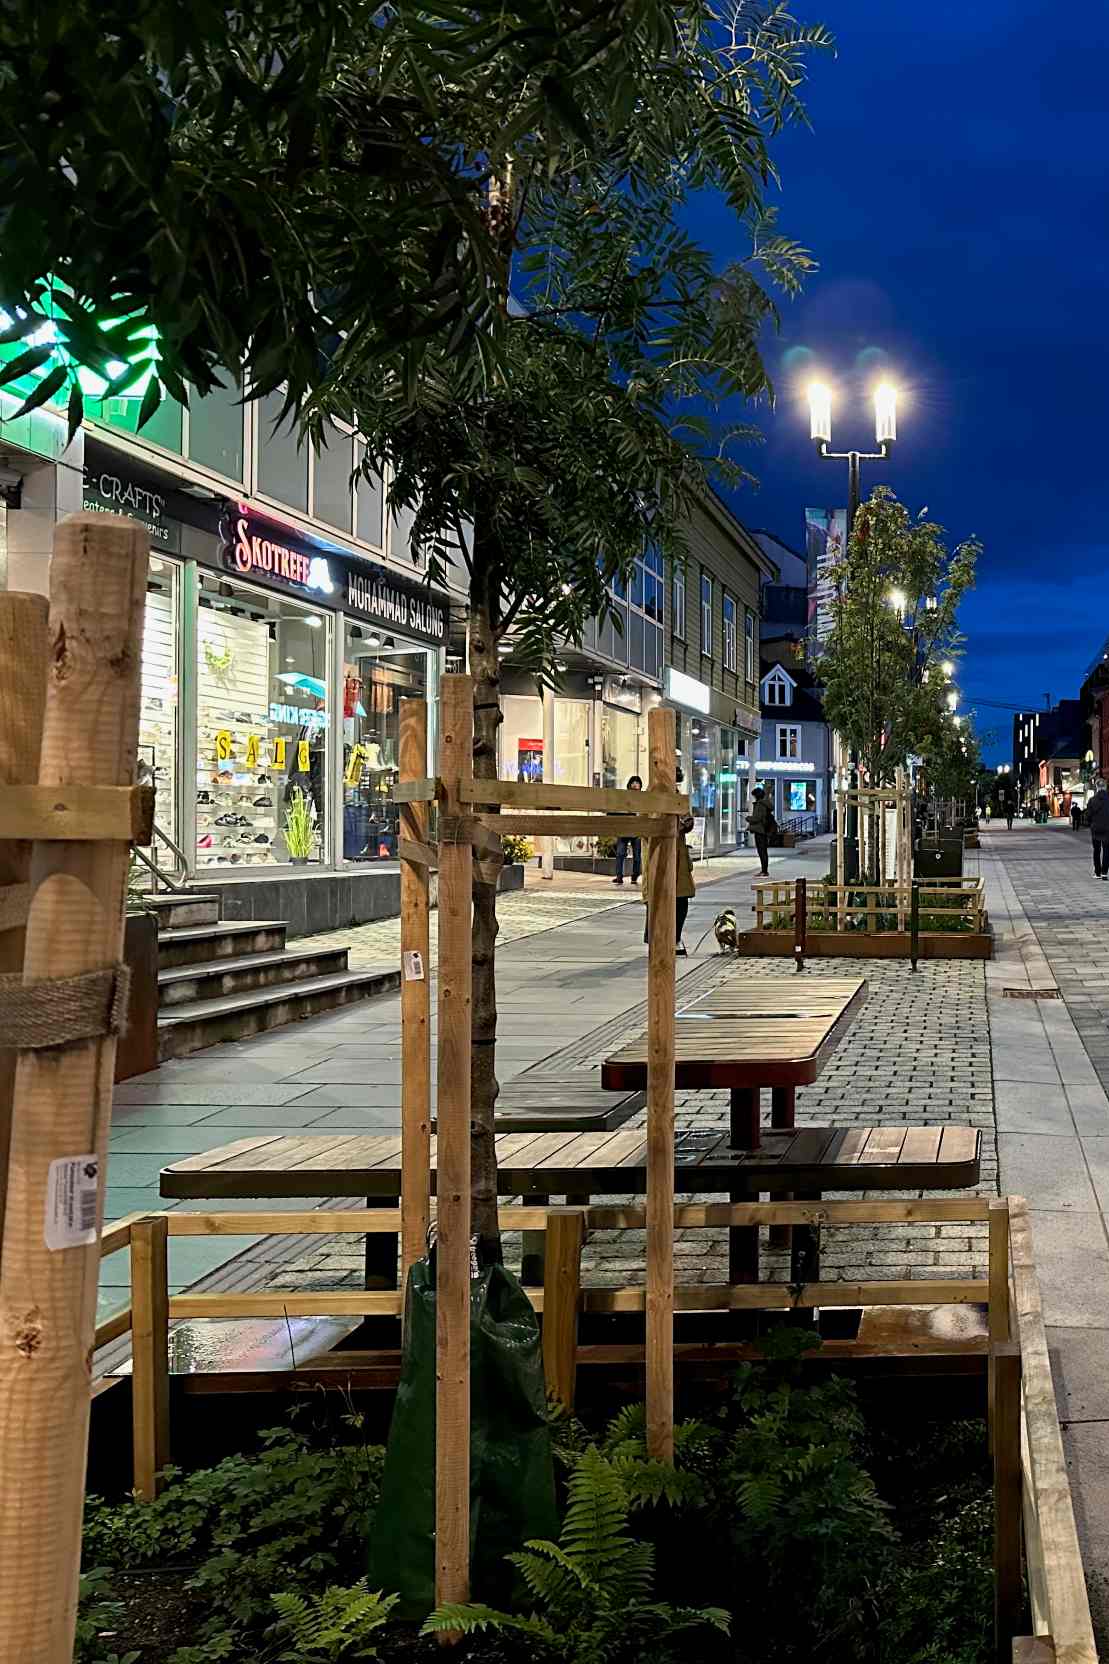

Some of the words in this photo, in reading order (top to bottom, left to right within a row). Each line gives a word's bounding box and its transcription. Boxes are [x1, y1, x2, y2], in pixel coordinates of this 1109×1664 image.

[235, 519, 311, 586] SKOTREFF
[348, 571, 408, 625] MOHAMMAD
[410, 597, 445, 639] SALONG
